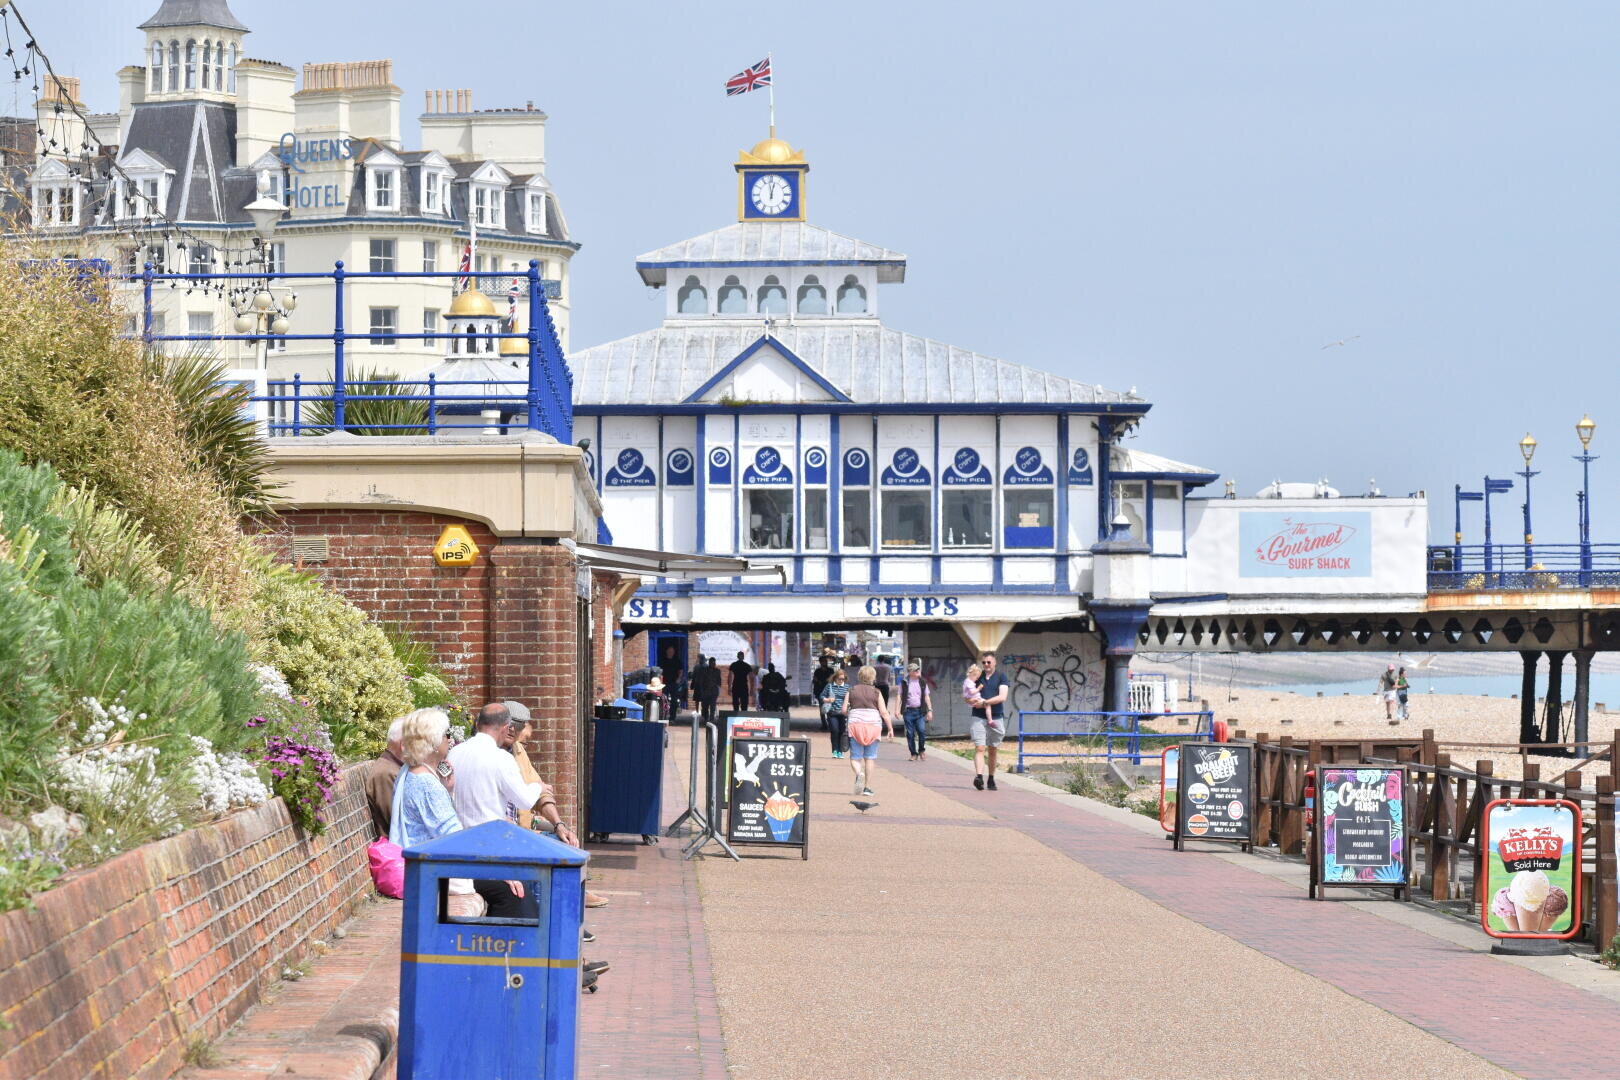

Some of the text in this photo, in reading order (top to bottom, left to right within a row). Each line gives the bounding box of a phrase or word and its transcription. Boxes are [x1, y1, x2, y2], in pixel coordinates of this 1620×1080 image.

[282, 175, 345, 208] HOTEL
[1291, 522, 1308, 536] The
[1267, 525, 1344, 561] Gourmet
[442, 551, 464, 560] IPS
[1288, 558, 1351, 570] SURF SHACK
[865, 597, 959, 616] CHIPS
[748, 743, 795, 760] FRIES
[770, 763, 804, 777] £3.75
[1193, 755, 1239, 775] DRAUGHT
[1211, 765, 1237, 779] BEER
[1338, 781, 1387, 807] Cocktail
[739, 802, 764, 811] SAUCES
[1354, 801, 1379, 812] SLUSH
[1503, 839, 1558, 854] KELLY'S
[1513, 859, 1552, 870] Sold Here
[456, 933, 518, 953] Litter
